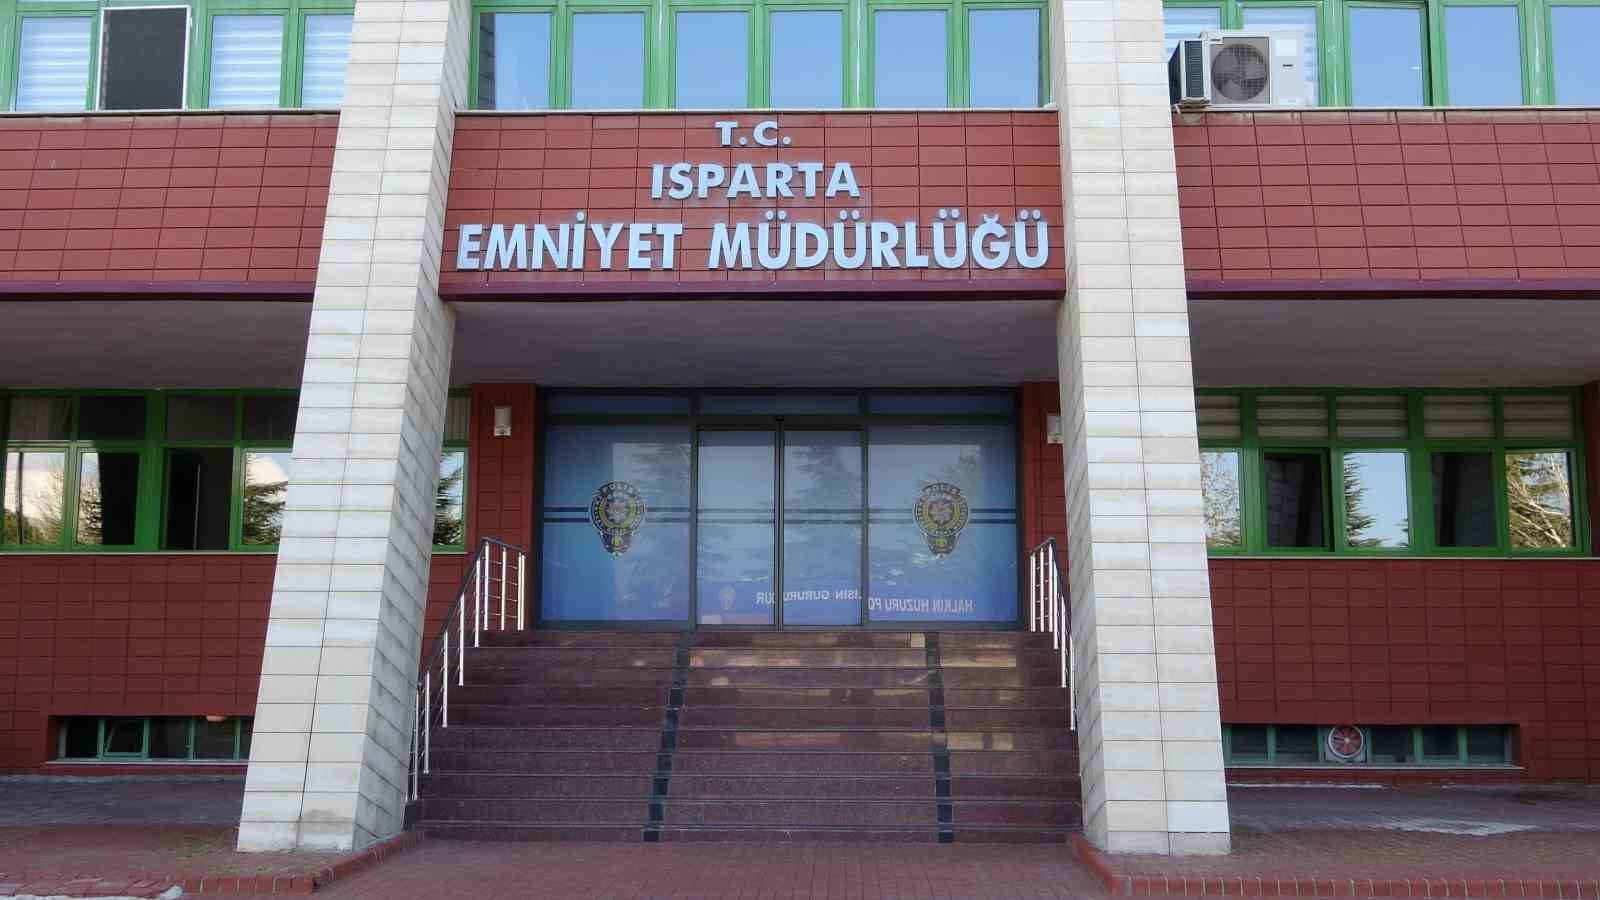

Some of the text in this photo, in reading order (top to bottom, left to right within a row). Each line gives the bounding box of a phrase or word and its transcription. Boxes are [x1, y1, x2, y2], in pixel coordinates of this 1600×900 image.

[715, 121, 791, 145] T.C.
[652, 162, 860, 199] ISPARTA
[457, 209, 1048, 269] EMNİYET MÜDÜRLÜĞÜ
